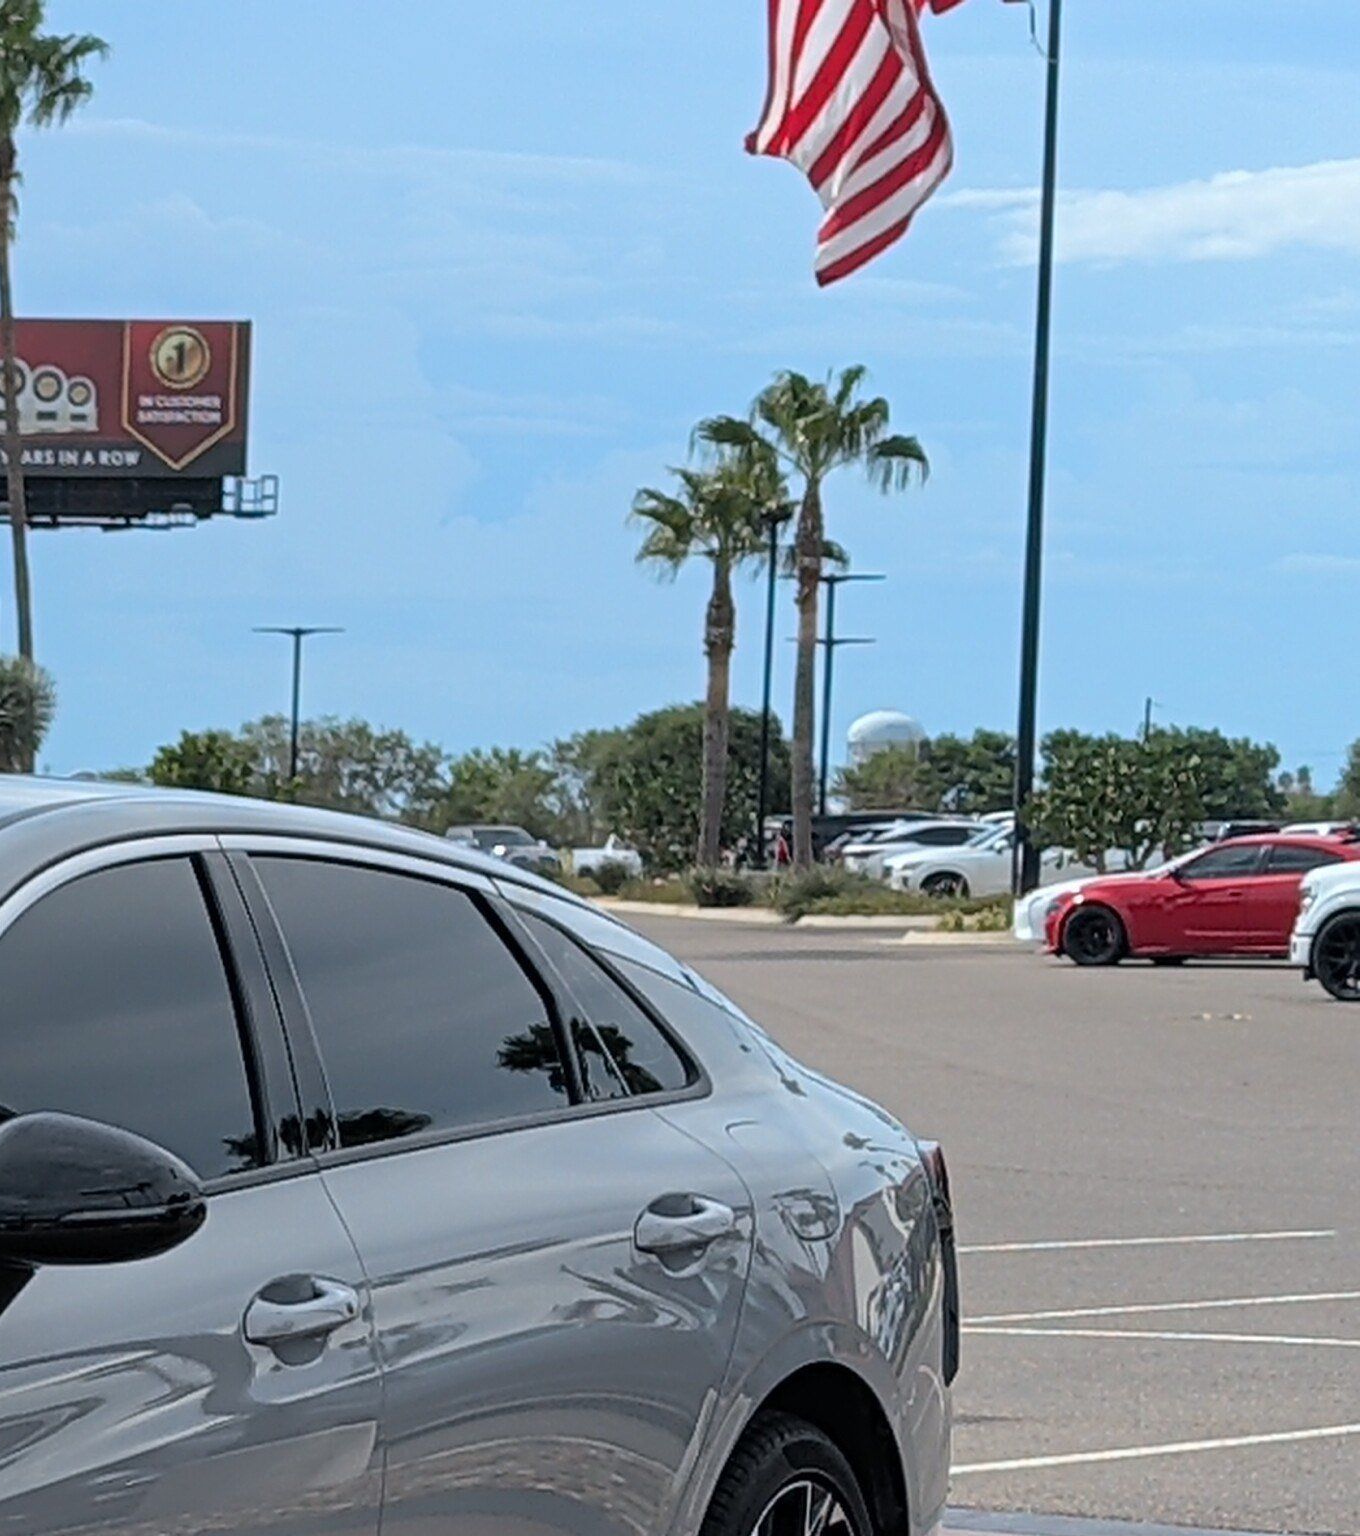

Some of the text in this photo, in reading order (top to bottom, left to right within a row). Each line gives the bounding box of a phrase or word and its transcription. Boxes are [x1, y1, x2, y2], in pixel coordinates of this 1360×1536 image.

[155, 395, 222, 409] CUSTOMER
[136, 409, 222, 424] SATISFACTION
[58, 450, 79, 466] IN
[81, 450, 96, 466] A
[98, 451, 141, 467] ROW
